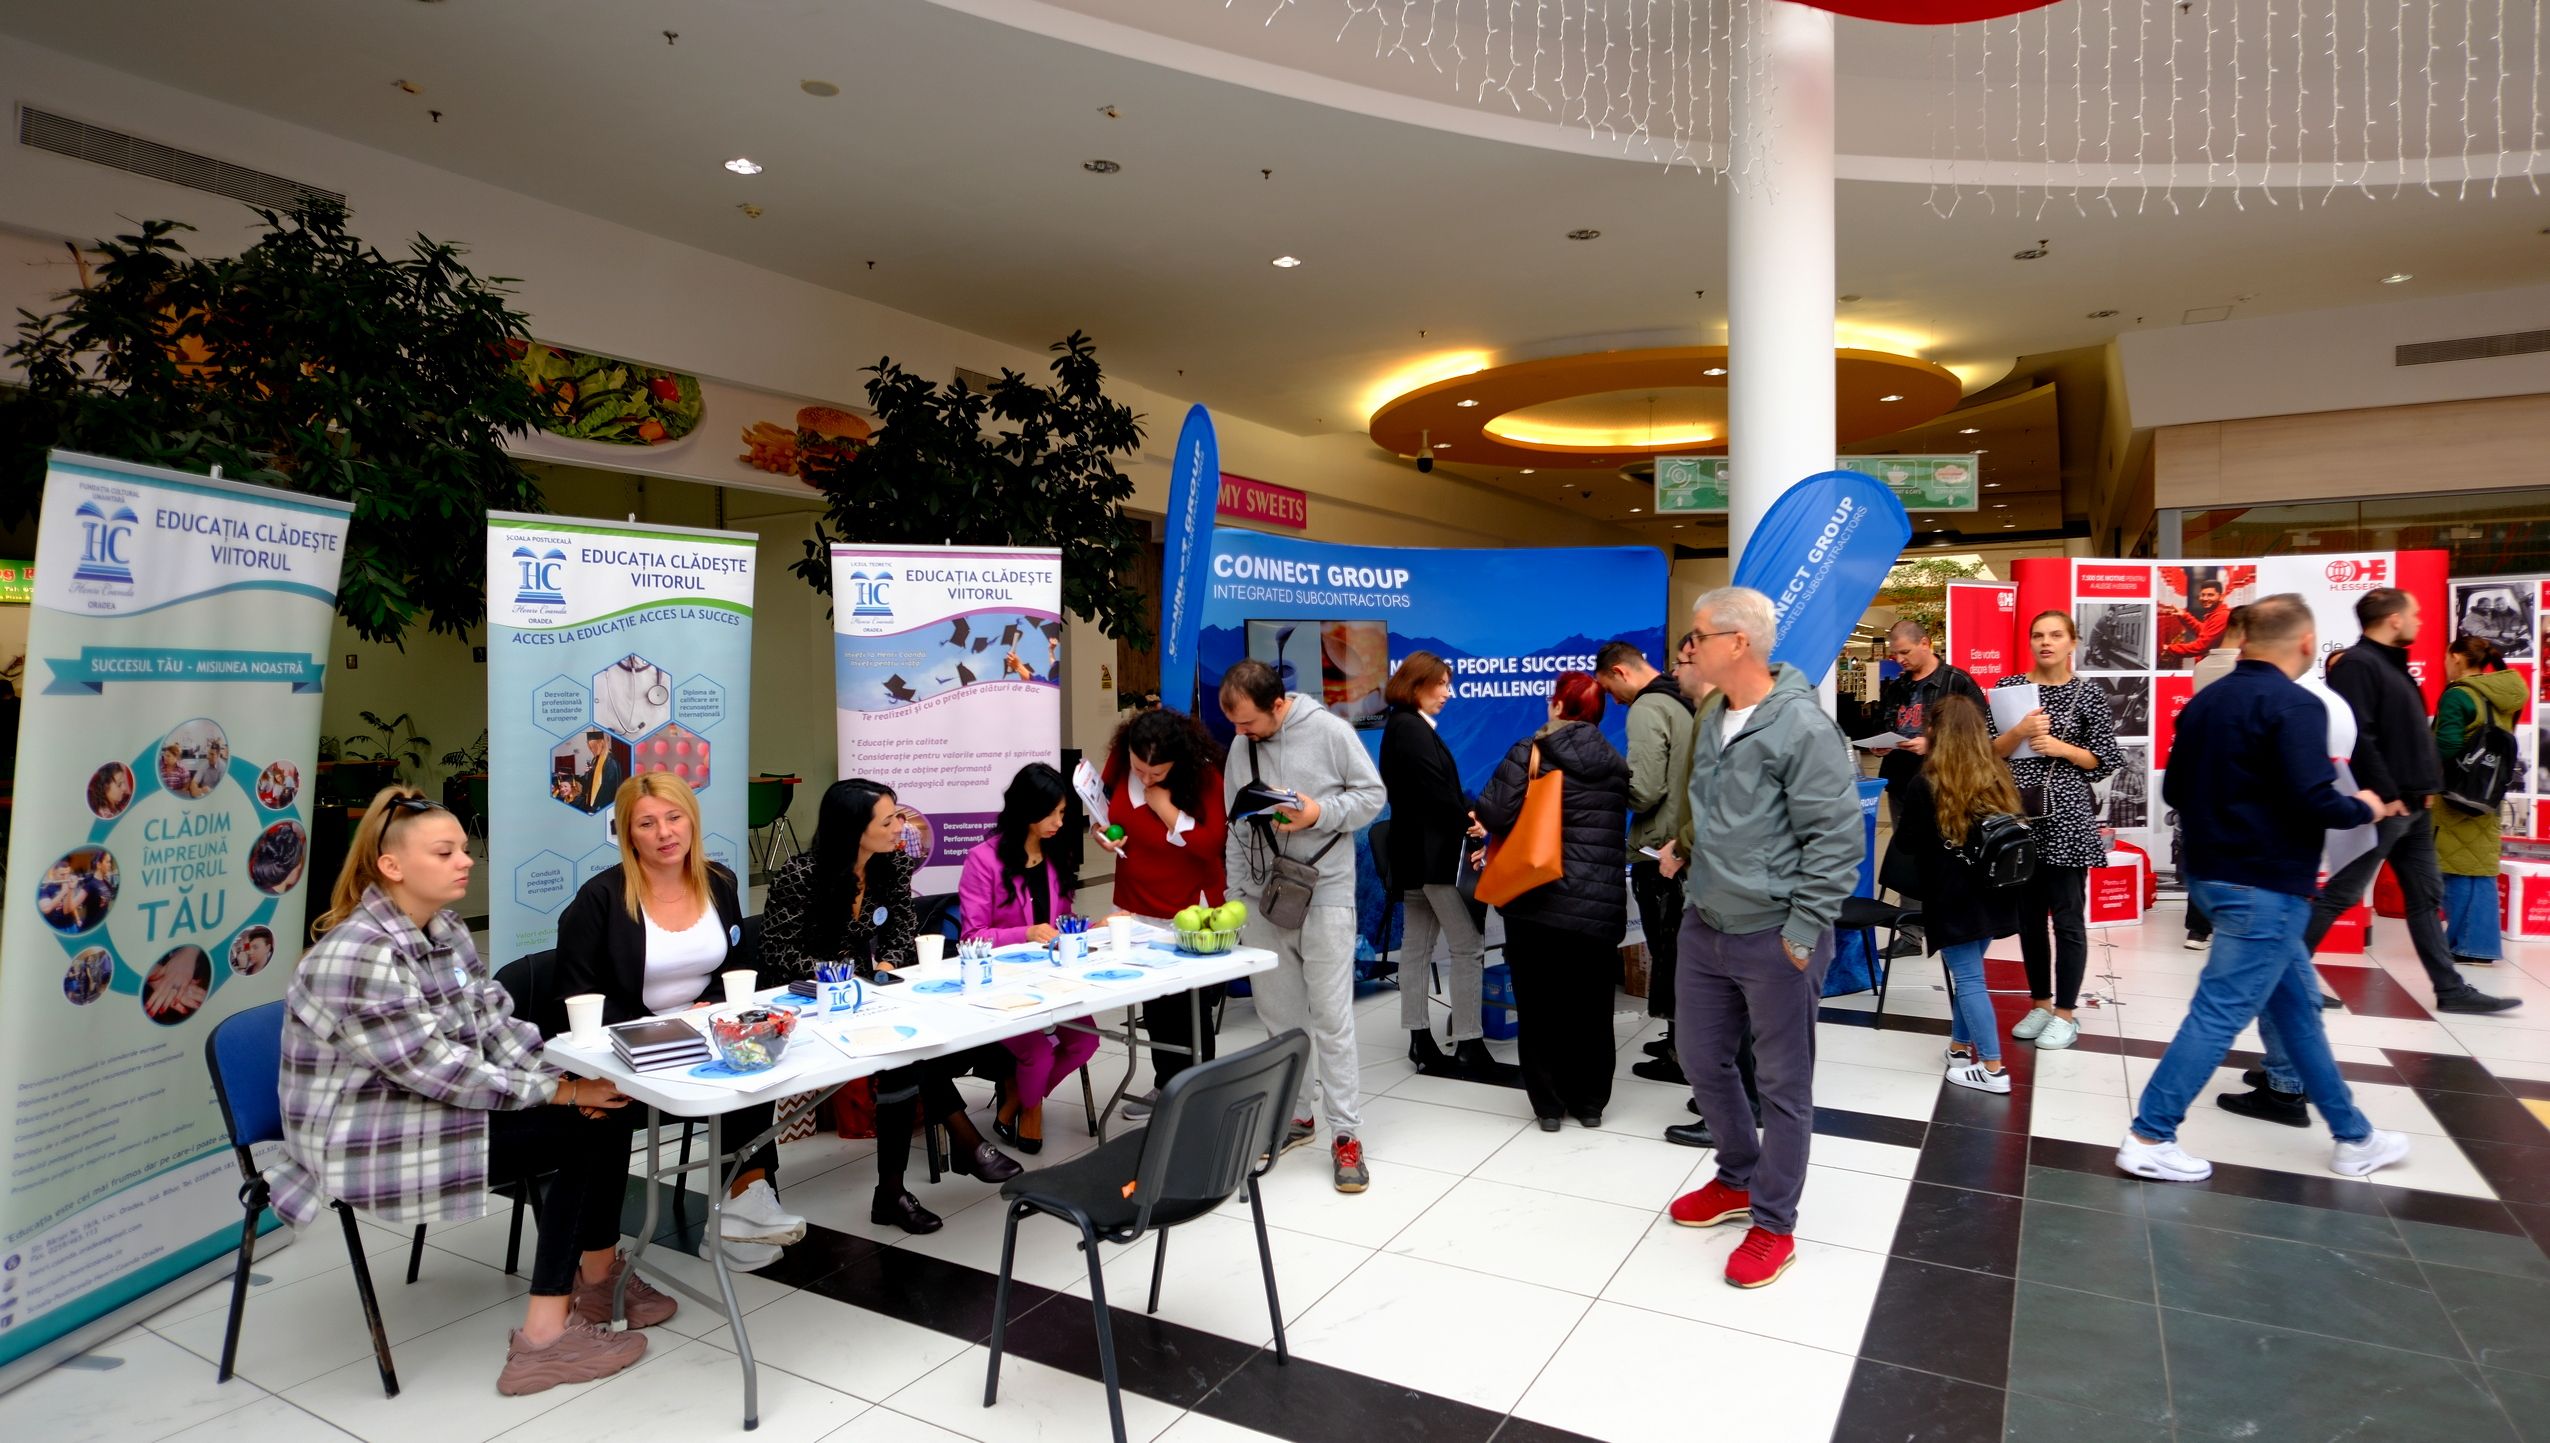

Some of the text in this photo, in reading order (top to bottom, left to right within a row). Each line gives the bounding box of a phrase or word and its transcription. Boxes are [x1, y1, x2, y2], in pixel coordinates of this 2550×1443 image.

[1247, 488, 1303, 522] SWEETS
[1808, 496, 1853, 564] GROUP
[211, 544, 291, 572] VIITORUL
[1802, 505, 1868, 600] SUBCONTRACTORS
[631, 573, 705, 590] VIITORUL
[1214, 555, 1409, 589] CONNECT GROUP
[948, 588, 1012, 600] VIITORUL
[1214, 585, 1410, 608] INTEGRATED SUBCONTRACTORS
[512, 632, 555, 645] ACCES
[559, 631, 575, 643] LA
[639, 609, 677, 624] ACCES
[681, 609, 695, 619] LA
[699, 610, 740, 626] SUCCES
[2322, 640, 2344, 653] de
[92, 659, 152, 673] SUCCESUL
[158, 656, 182, 673] TĂU
[197, 660, 248, 674] MISIUNEA
[252, 660, 303, 675] NOASTRĂ
[1458, 655, 1597, 674] PEOPLE SUCCESS
[1459, 680, 1556, 698] CHALLENGI
[541, 698, 582, 706] profesională
[862, 712, 872, 721] Te
[875, 709, 912, 721] realizezi
[924, 701, 934, 711] cu
[936, 698, 941, 706] o
[943, 687, 978, 704] profesie
[980, 683, 1010, 694] alături
[1012, 683, 1023, 692] de
[1025, 685, 1040, 694] Bac
[896, 738, 913, 748] prin
[915, 737, 948, 746] calitate
[913, 751, 941, 760] pentru
[943, 750, 974, 758] valorile
[1014, 749, 1052, 758] spirituale
[892, 766, 903, 774] de
[898, 778, 944, 790] pedagogică
[947, 778, 990, 787] europeană
[144, 810, 231, 841] CLĂDIM
[143, 836, 228, 866] ÎMPREUNĂ
[944, 848, 969, 856] Integrit
[141, 859, 227, 887] VIITORUL
[527, 877, 564, 887] pedagogică
[531, 869, 561, 878] Conduită
[528, 885, 564, 894] europeană
[138, 884, 225, 942] TĂU
[55, 1201, 74, 1216] este
[77, 1191, 90, 1204] cel
[92, 1183, 109, 1195] mai
[111, 1168, 142, 1187] frumos
[144, 1161, 157, 1172] dar
[159, 1155, 170, 1168] pe
[195, 1136, 217, 1152] poate
